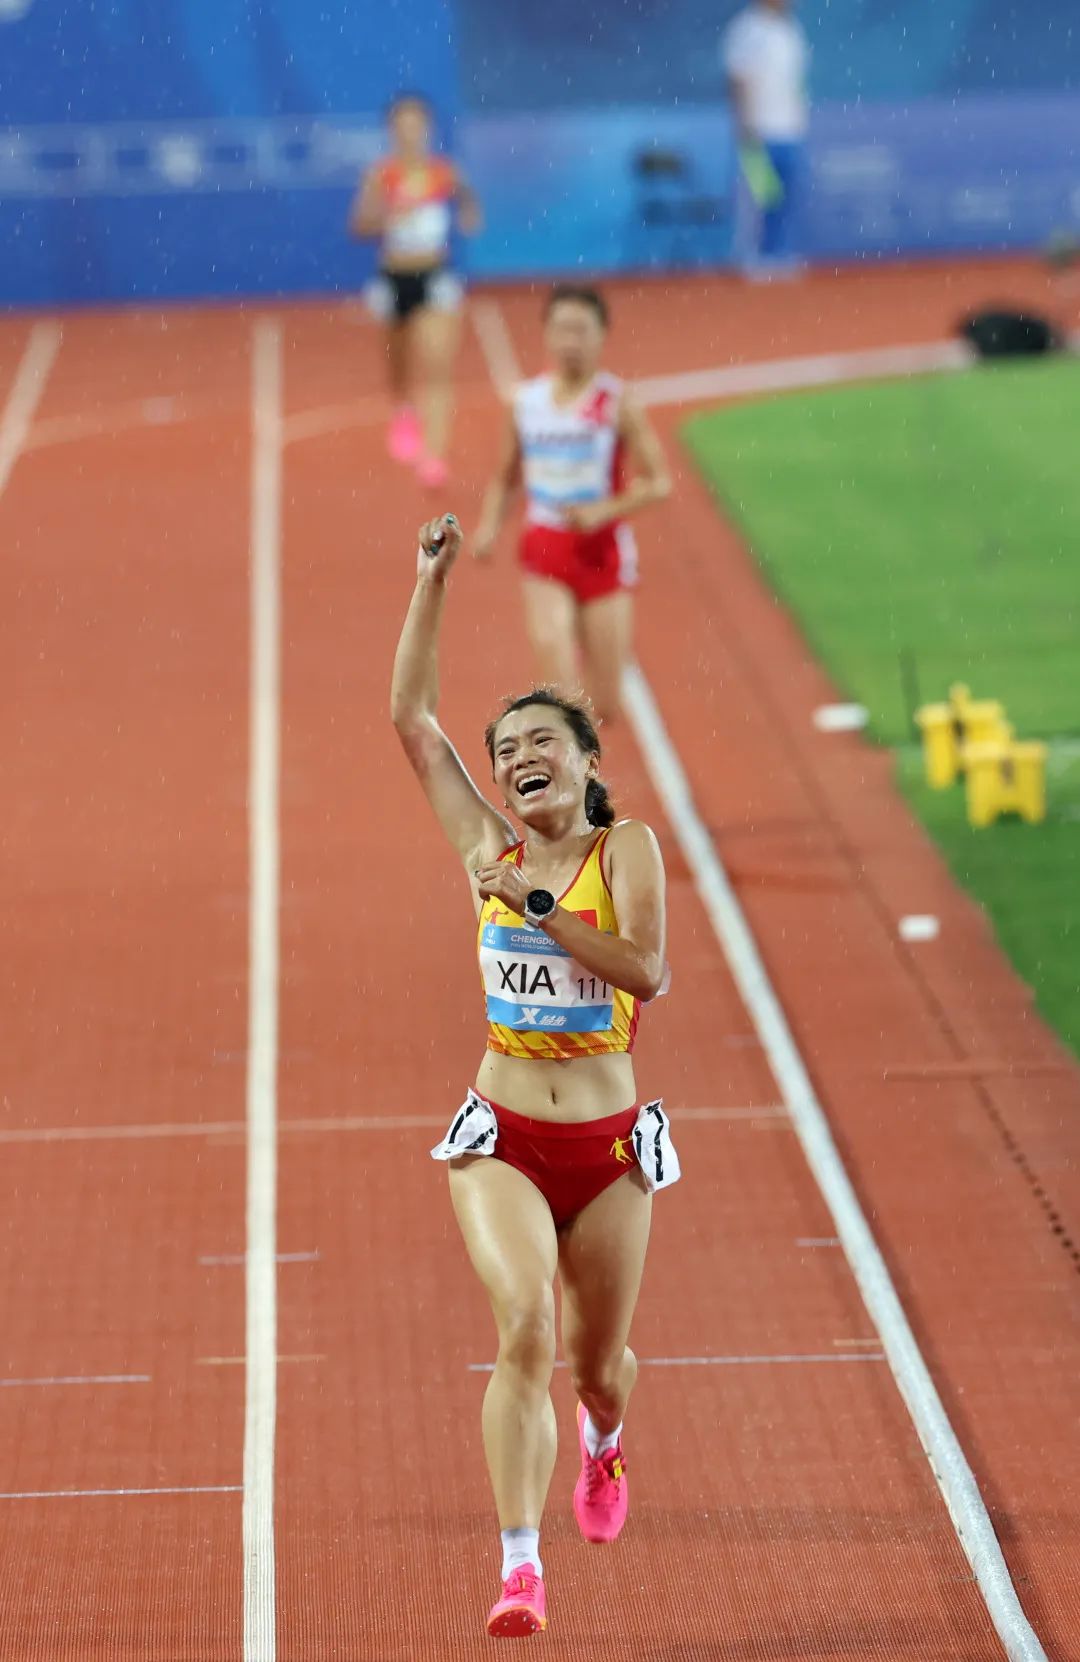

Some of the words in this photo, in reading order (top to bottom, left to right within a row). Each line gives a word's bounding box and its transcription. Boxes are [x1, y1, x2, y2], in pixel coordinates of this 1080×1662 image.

[511, 934, 556, 946] CHENGDU
[497, 961, 556, 996] XIA
[577, 977, 607, 1000] 111
